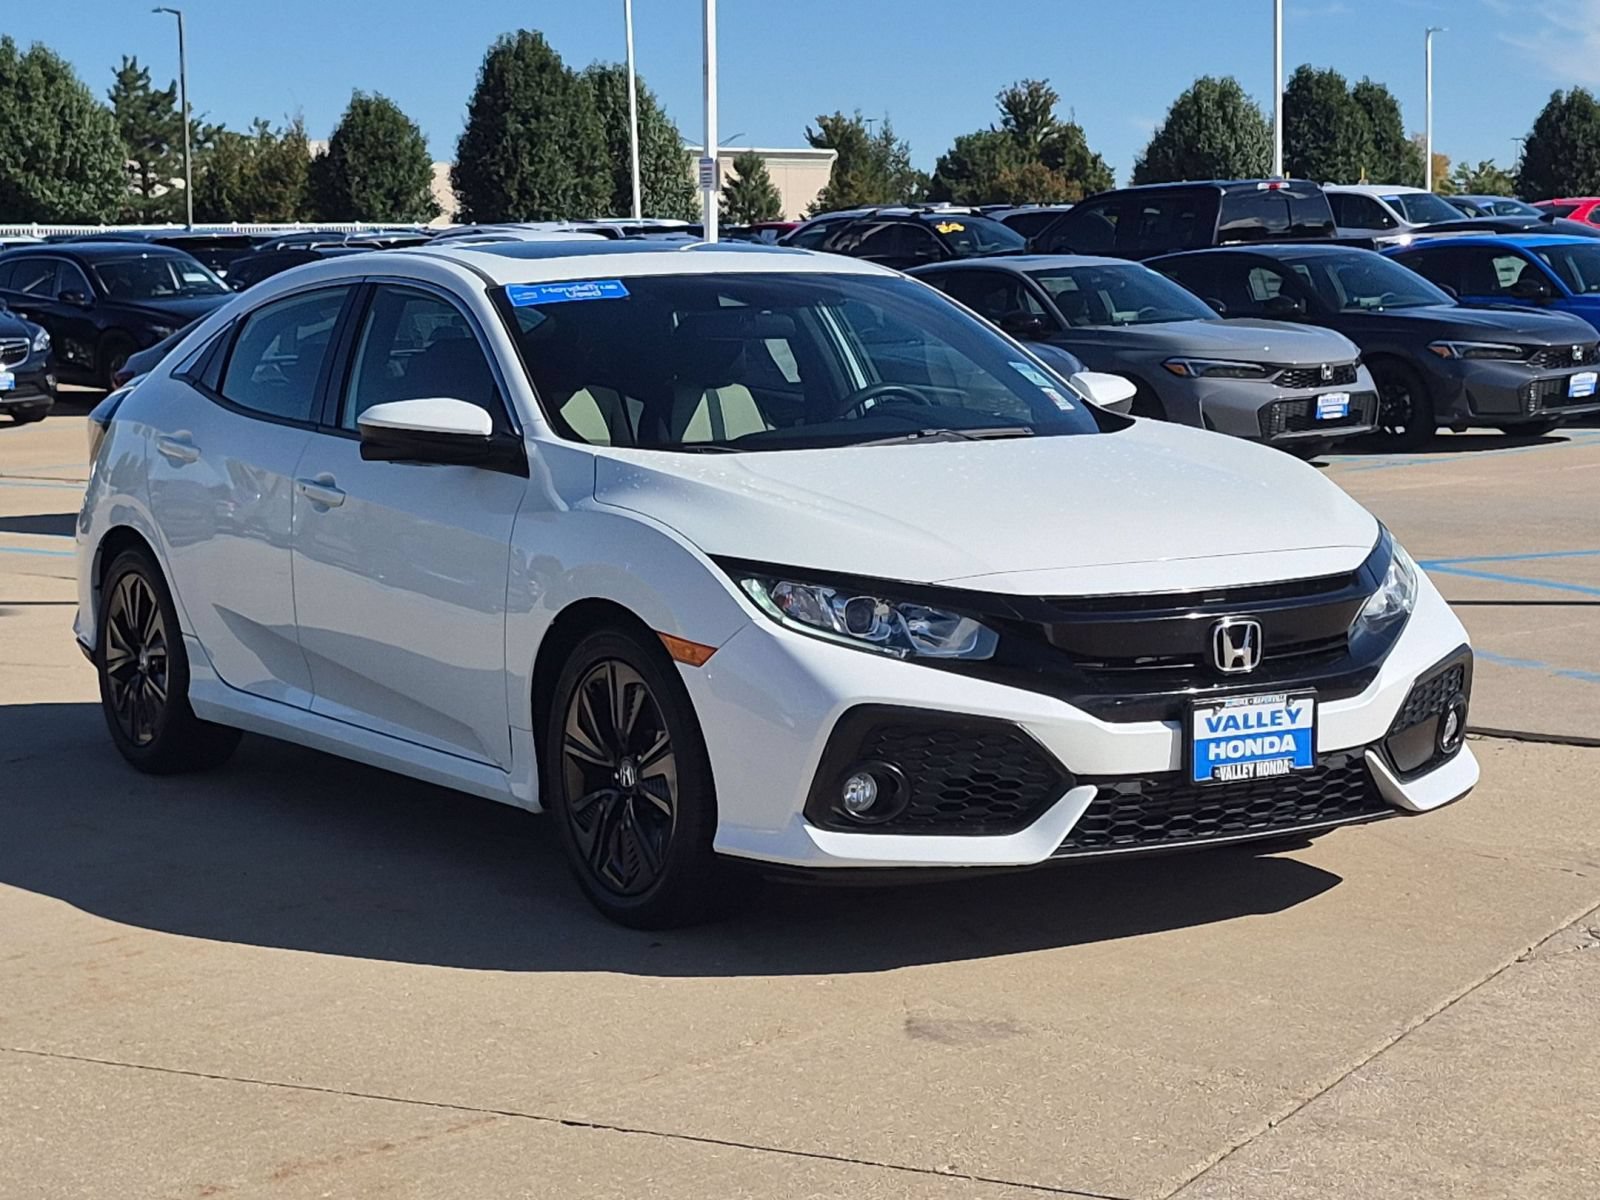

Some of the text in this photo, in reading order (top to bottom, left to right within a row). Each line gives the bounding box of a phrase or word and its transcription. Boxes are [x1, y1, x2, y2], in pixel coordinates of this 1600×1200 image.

[1205, 707, 1302, 733] VALLEY
[1208, 734, 1296, 760] HONDA
[1220, 759, 1290, 781] VALLEY HONDA
